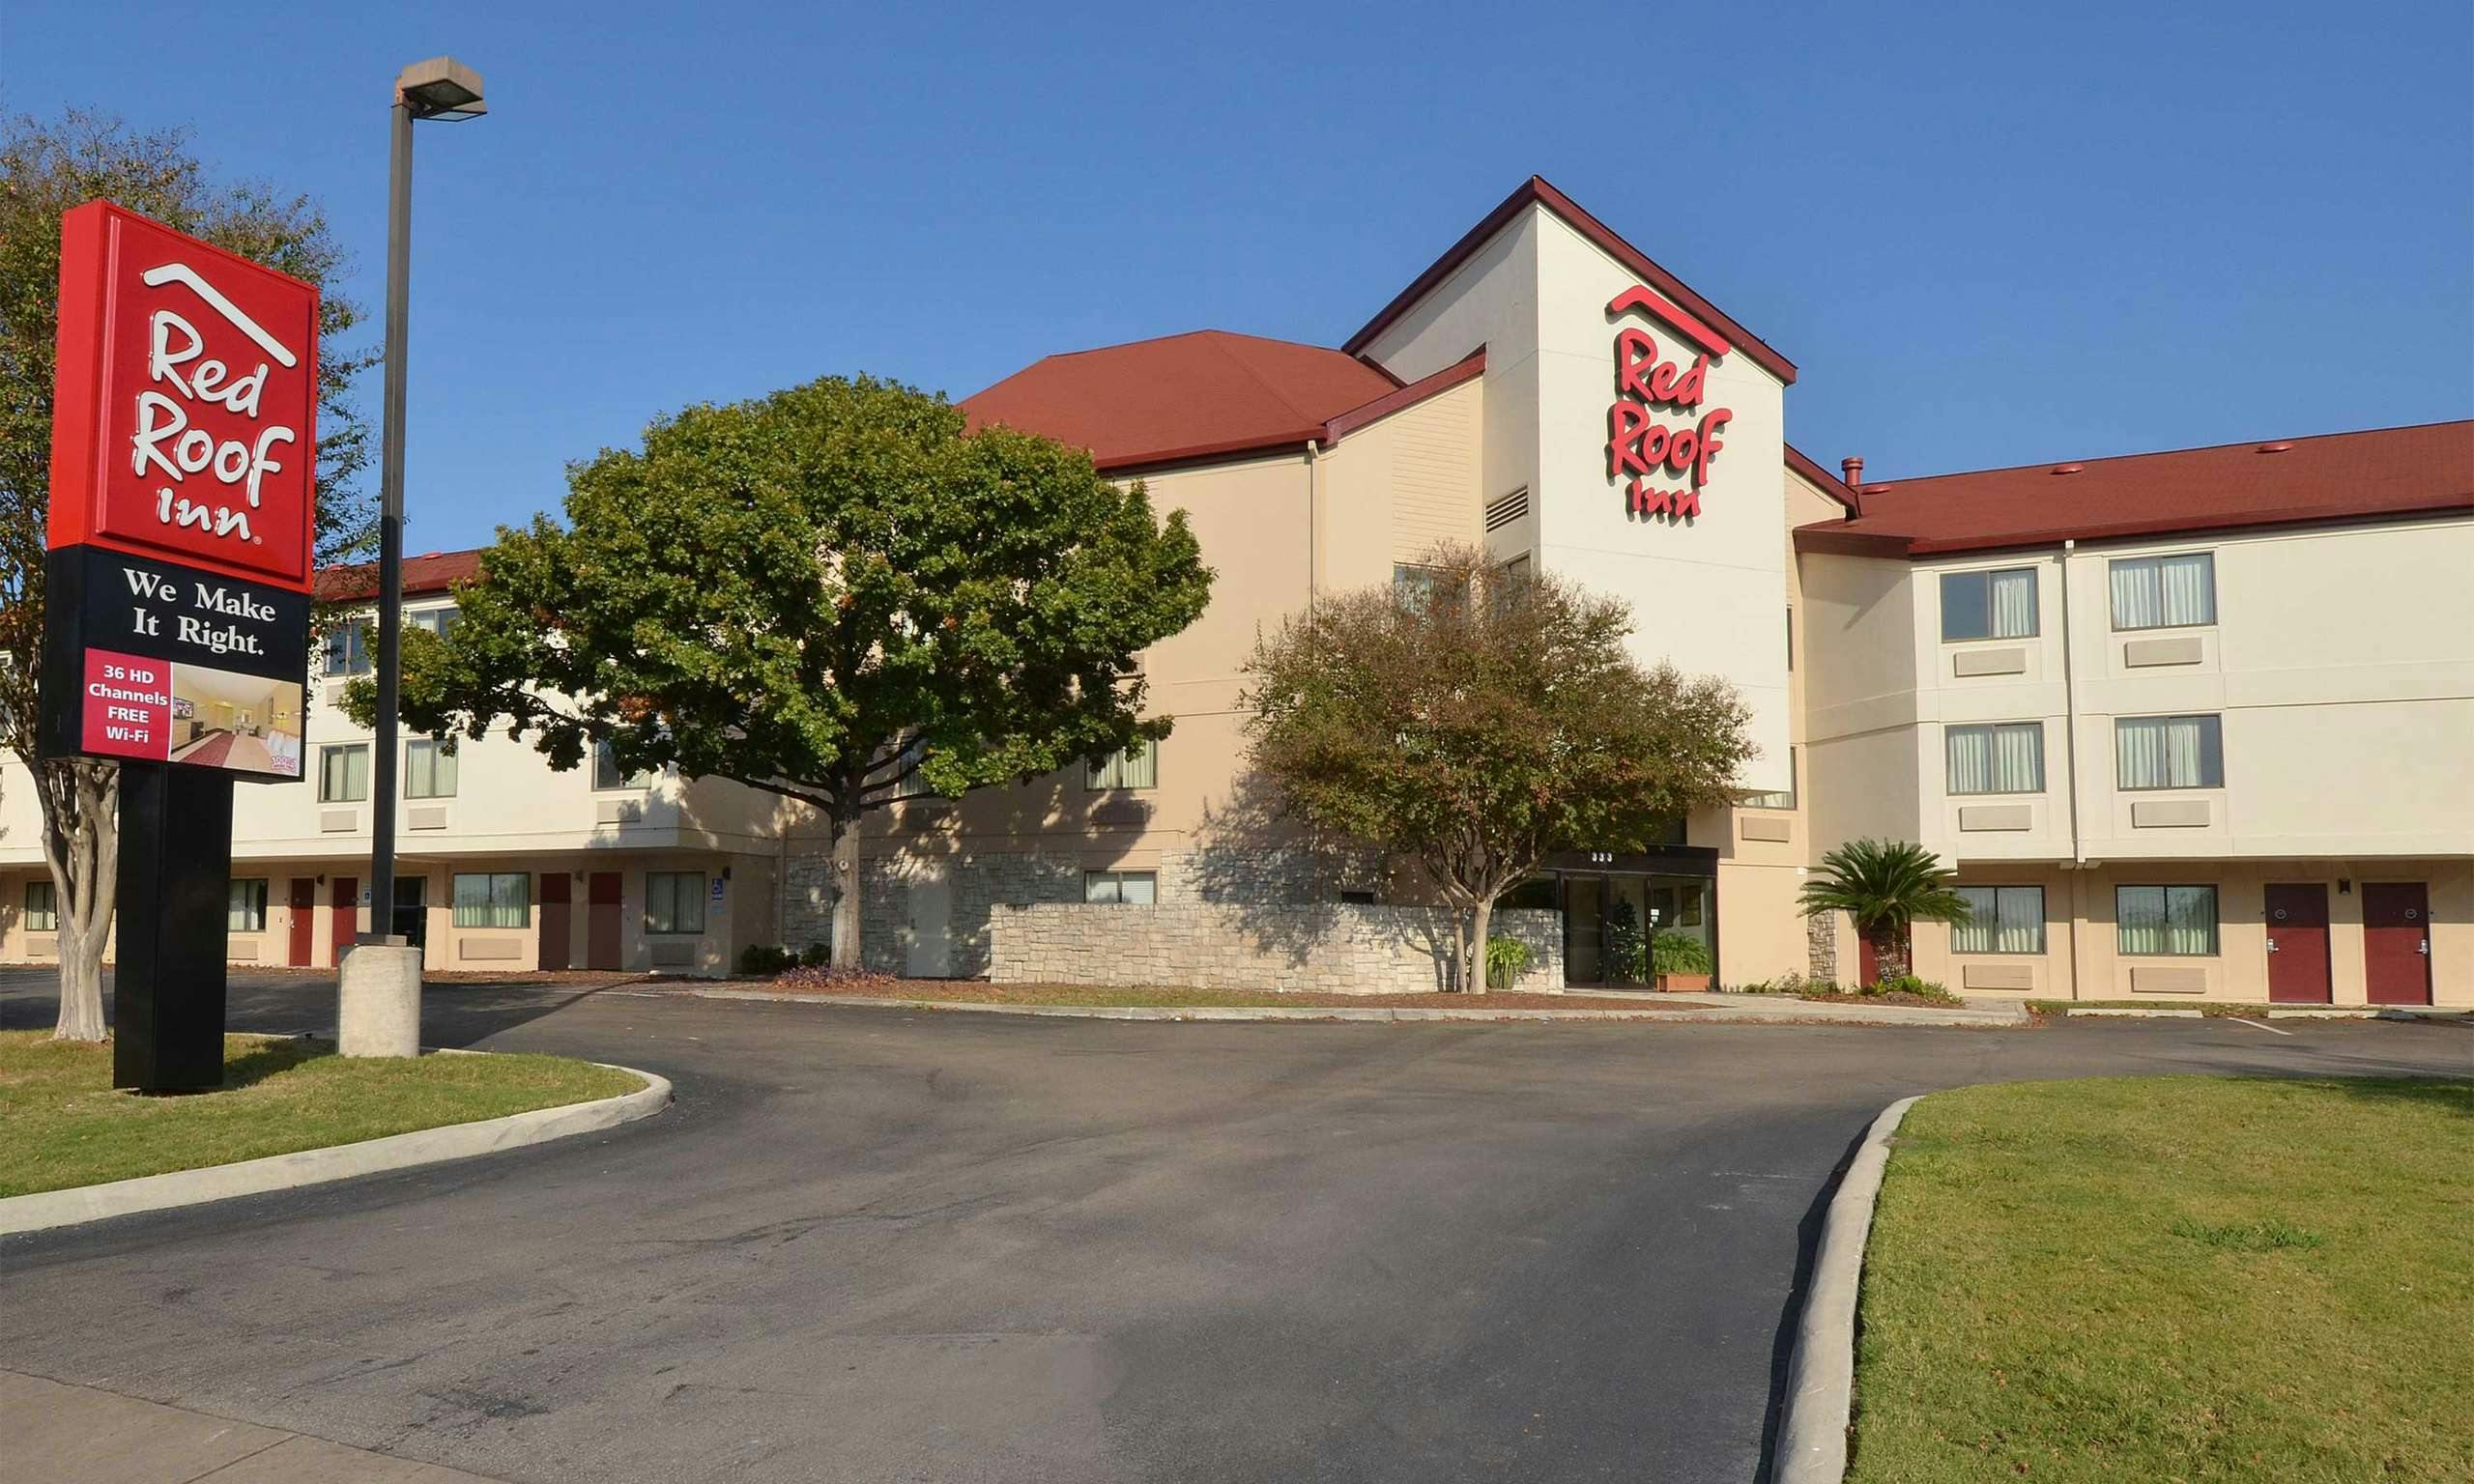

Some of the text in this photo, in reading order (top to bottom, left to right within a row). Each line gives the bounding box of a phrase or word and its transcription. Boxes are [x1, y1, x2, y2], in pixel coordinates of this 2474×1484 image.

[150, 310, 269, 417] Red
[1619, 327, 1709, 406] Red
[132, 391, 296, 508] Roof
[1611, 399, 1733, 486] Roof
[1631, 479, 1701, 517] Inn
[123, 567, 276, 622] We Make
[132, 607, 265, 656] It Right.
[88, 683, 168, 706] Channels
[103, 665, 155, 684] 36 HD
[105, 726, 149, 743] Wi-Fi
[107, 707, 150, 724] FREE
